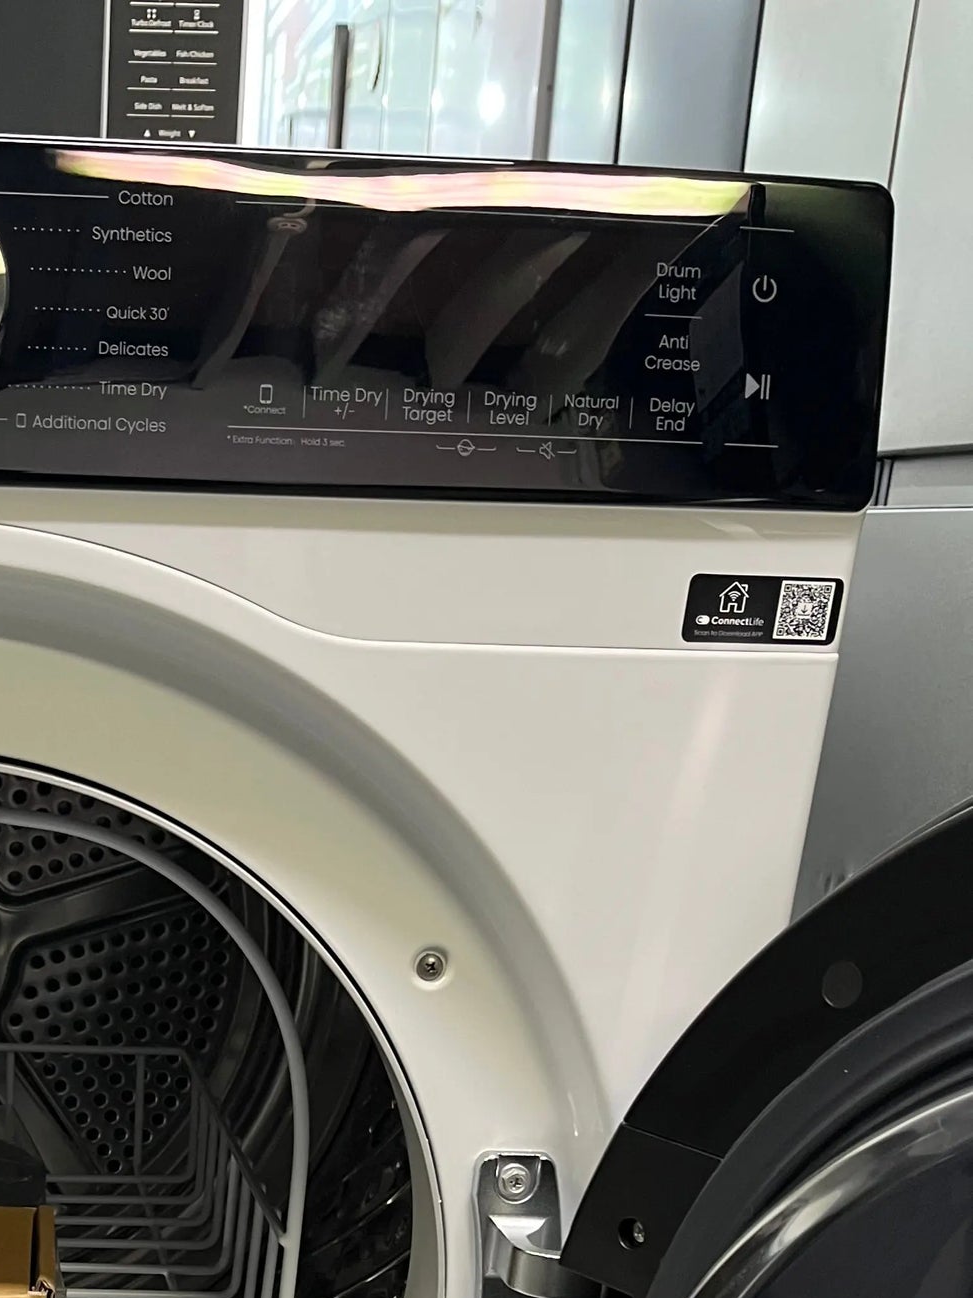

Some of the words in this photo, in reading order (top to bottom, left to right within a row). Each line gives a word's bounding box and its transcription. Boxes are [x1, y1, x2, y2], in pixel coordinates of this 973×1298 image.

[118, 190, 174, 206] Cotton
[91, 225, 173, 244] Synthetics
[132, 265, 172, 281] Wool
[656, 262, 701, 280] Drum
[658, 283, 696, 303] Light
[106, 305, 147, 321] Quick
[98, 340, 169, 357] Delicates
[658, 334, 689, 350] Anti
[644, 355, 701, 372] Crease
[99, 380, 137, 396] Time
[140, 382, 167, 401] Dry
[311, 386, 351, 402] Time
[355, 387, 383, 406] Dry
[403, 388, 455, 408] Drying
[484, 391, 537, 411] Drying
[564, 393, 619, 410] Natural
[649, 398, 695, 416] Delay
[402, 406, 453, 425] Target
[489, 410, 529, 426] Level
[578, 412, 603, 430] Dry
[655, 415, 685, 432] End
[32, 414, 111, 432] Additional
[115, 417, 167, 435] Cycles
[232, 434, 254, 444] Extra
[301, 437, 321, 446] Hold
[711, 616, 765, 626] ConnectLife
